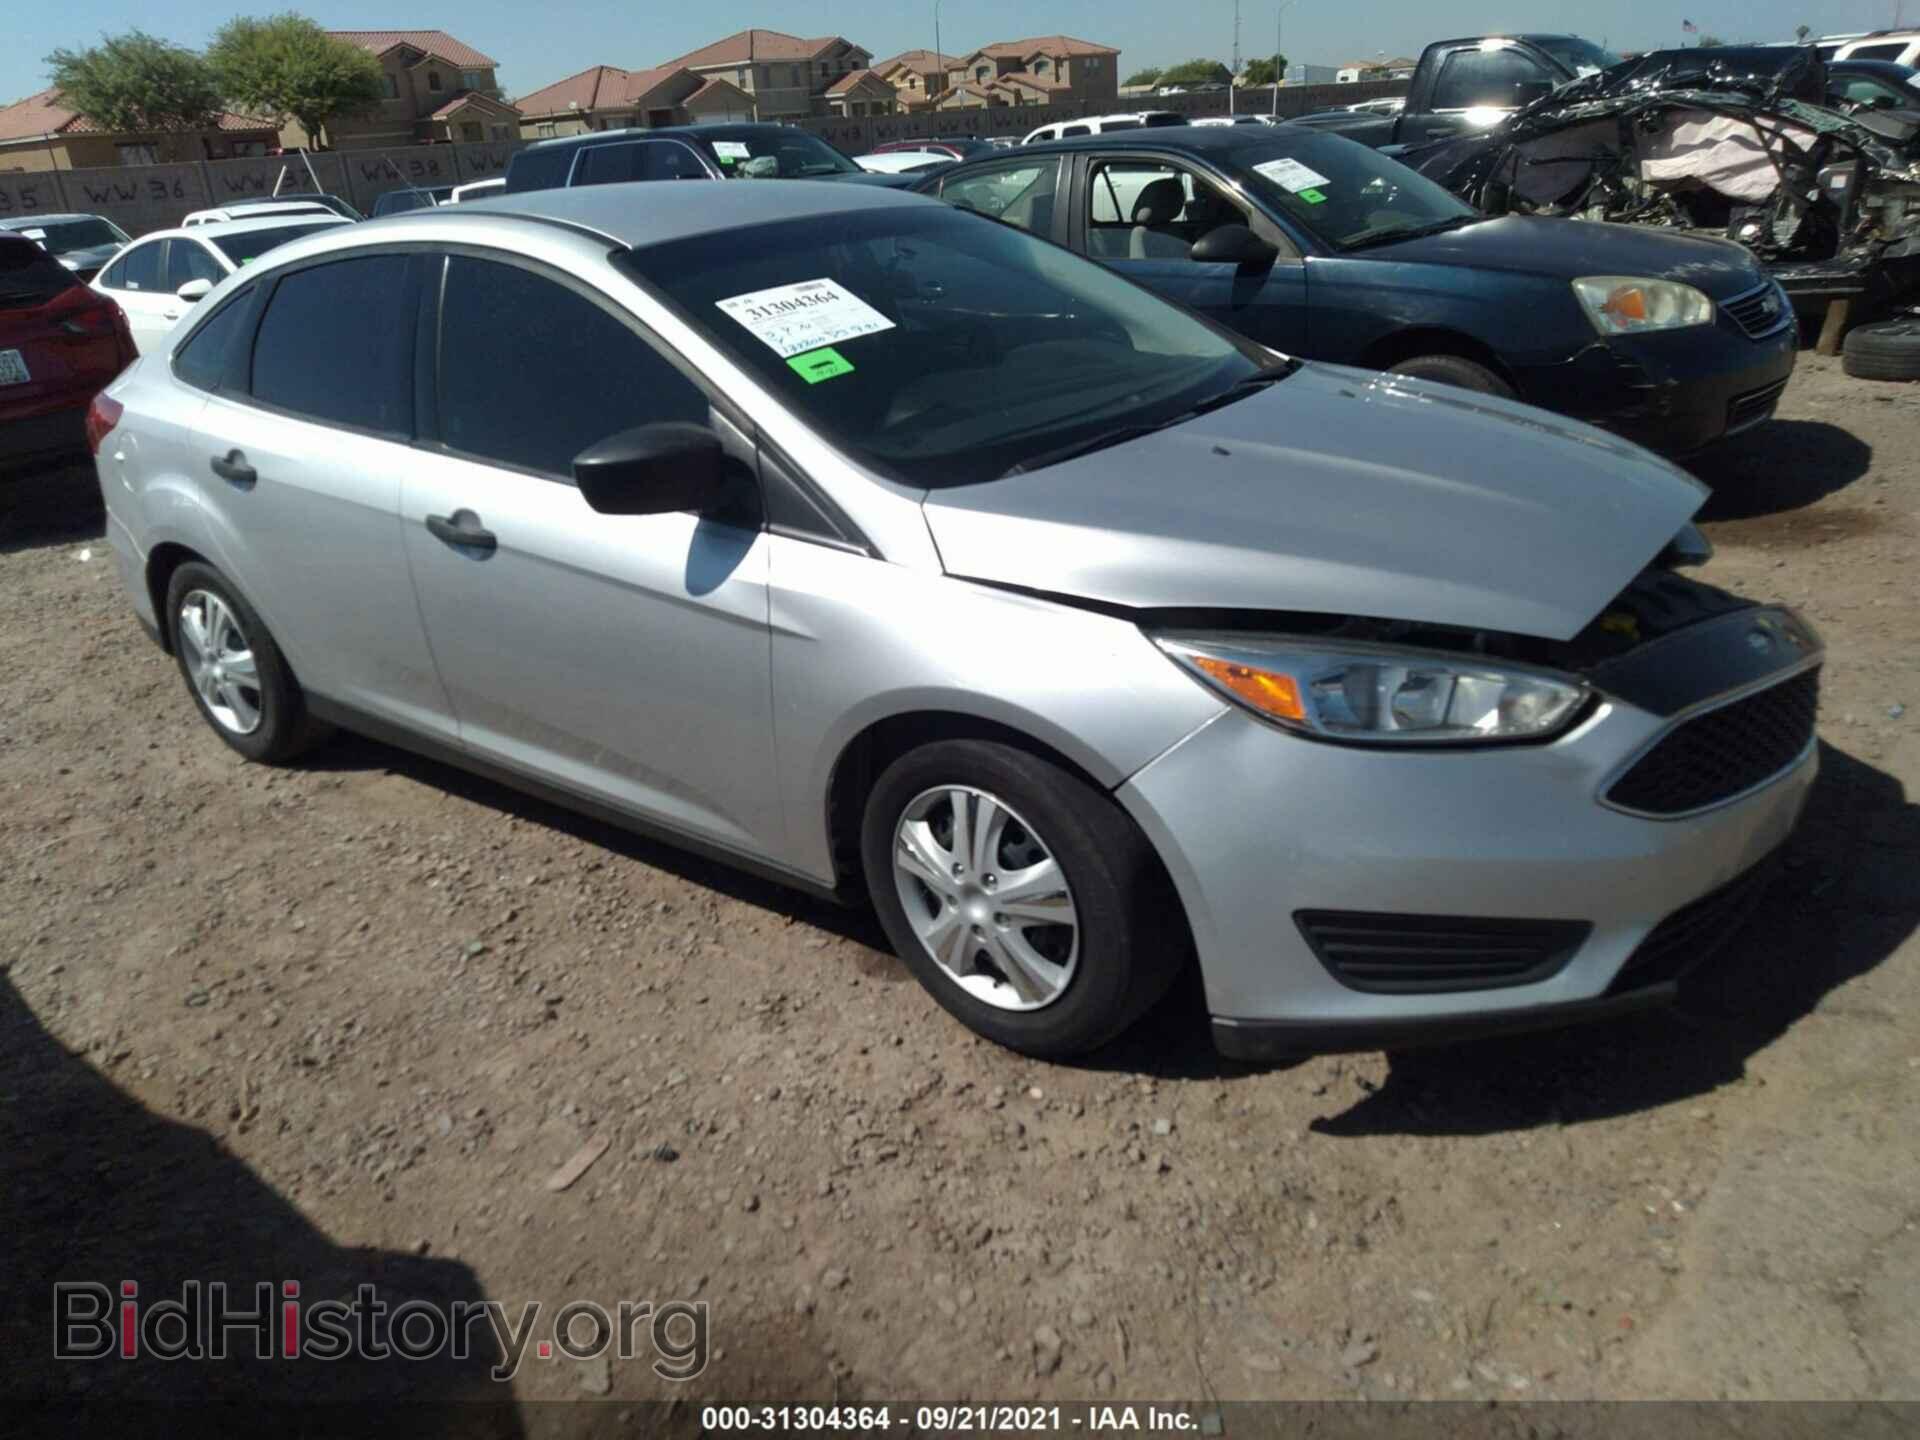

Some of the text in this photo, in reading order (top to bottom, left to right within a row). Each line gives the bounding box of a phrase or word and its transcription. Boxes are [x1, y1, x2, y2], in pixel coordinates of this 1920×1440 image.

[410, 159, 441, 177] 38
[82, 176, 185, 204] WW 36
[745, 291, 840, 321] 31304364
